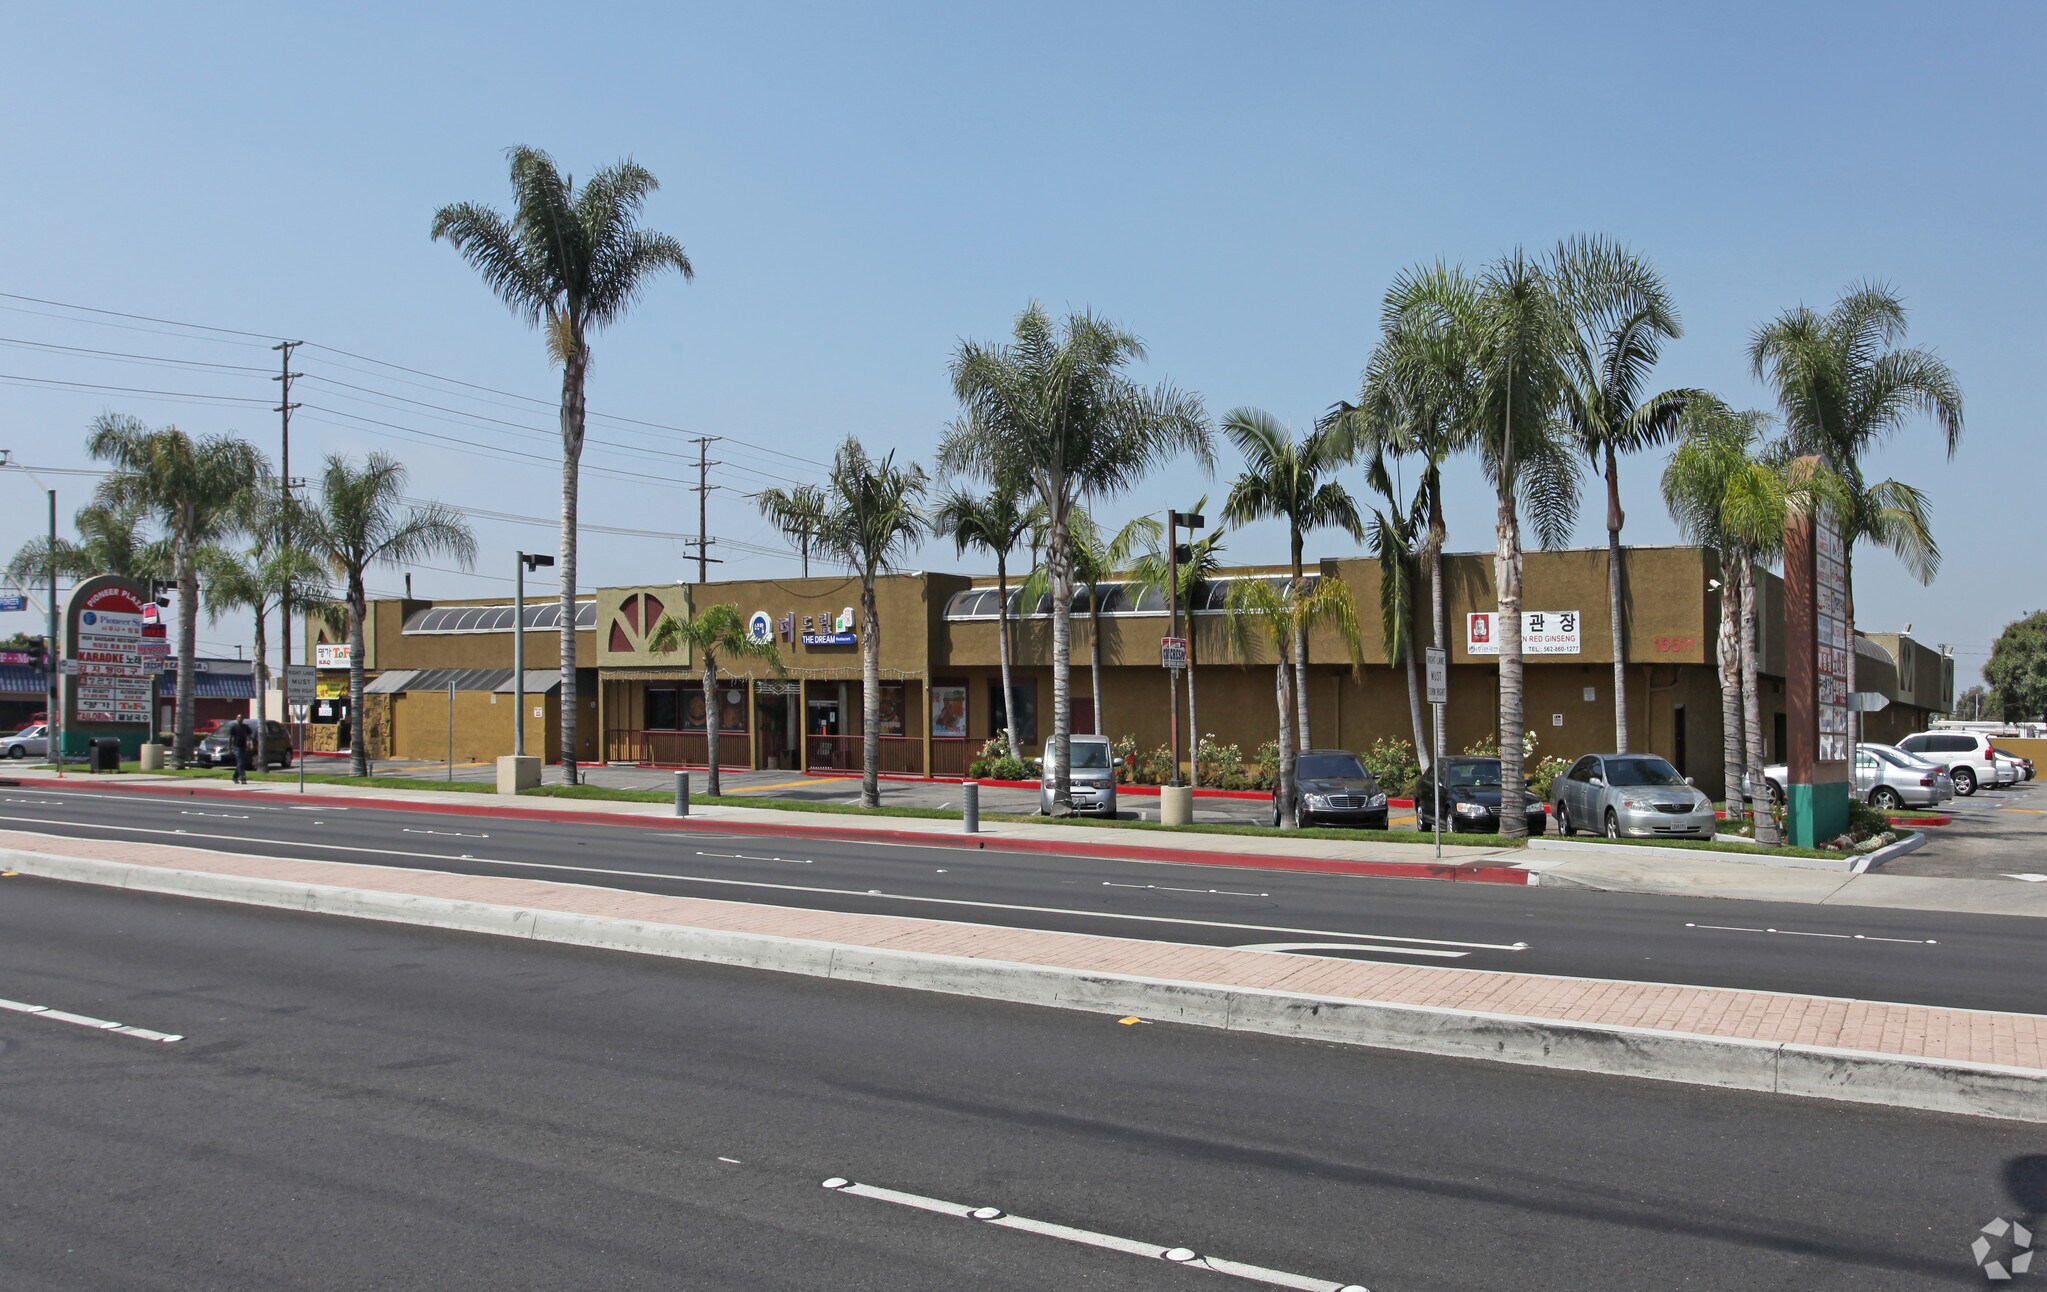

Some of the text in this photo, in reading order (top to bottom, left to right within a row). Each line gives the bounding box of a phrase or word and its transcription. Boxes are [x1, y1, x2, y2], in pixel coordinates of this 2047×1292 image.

[87, 588, 120, 607] PIONEER
[100, 616, 131, 626] Pioneer
[802, 635, 814, 643] THE
[815, 635, 835, 643] DREAM
[1655, 638, 1695, 652] 16511
[78, 652, 124, 664] KARAOKE
[333, 648, 350, 658] ToF
[1431, 672, 1441, 681] MUST
